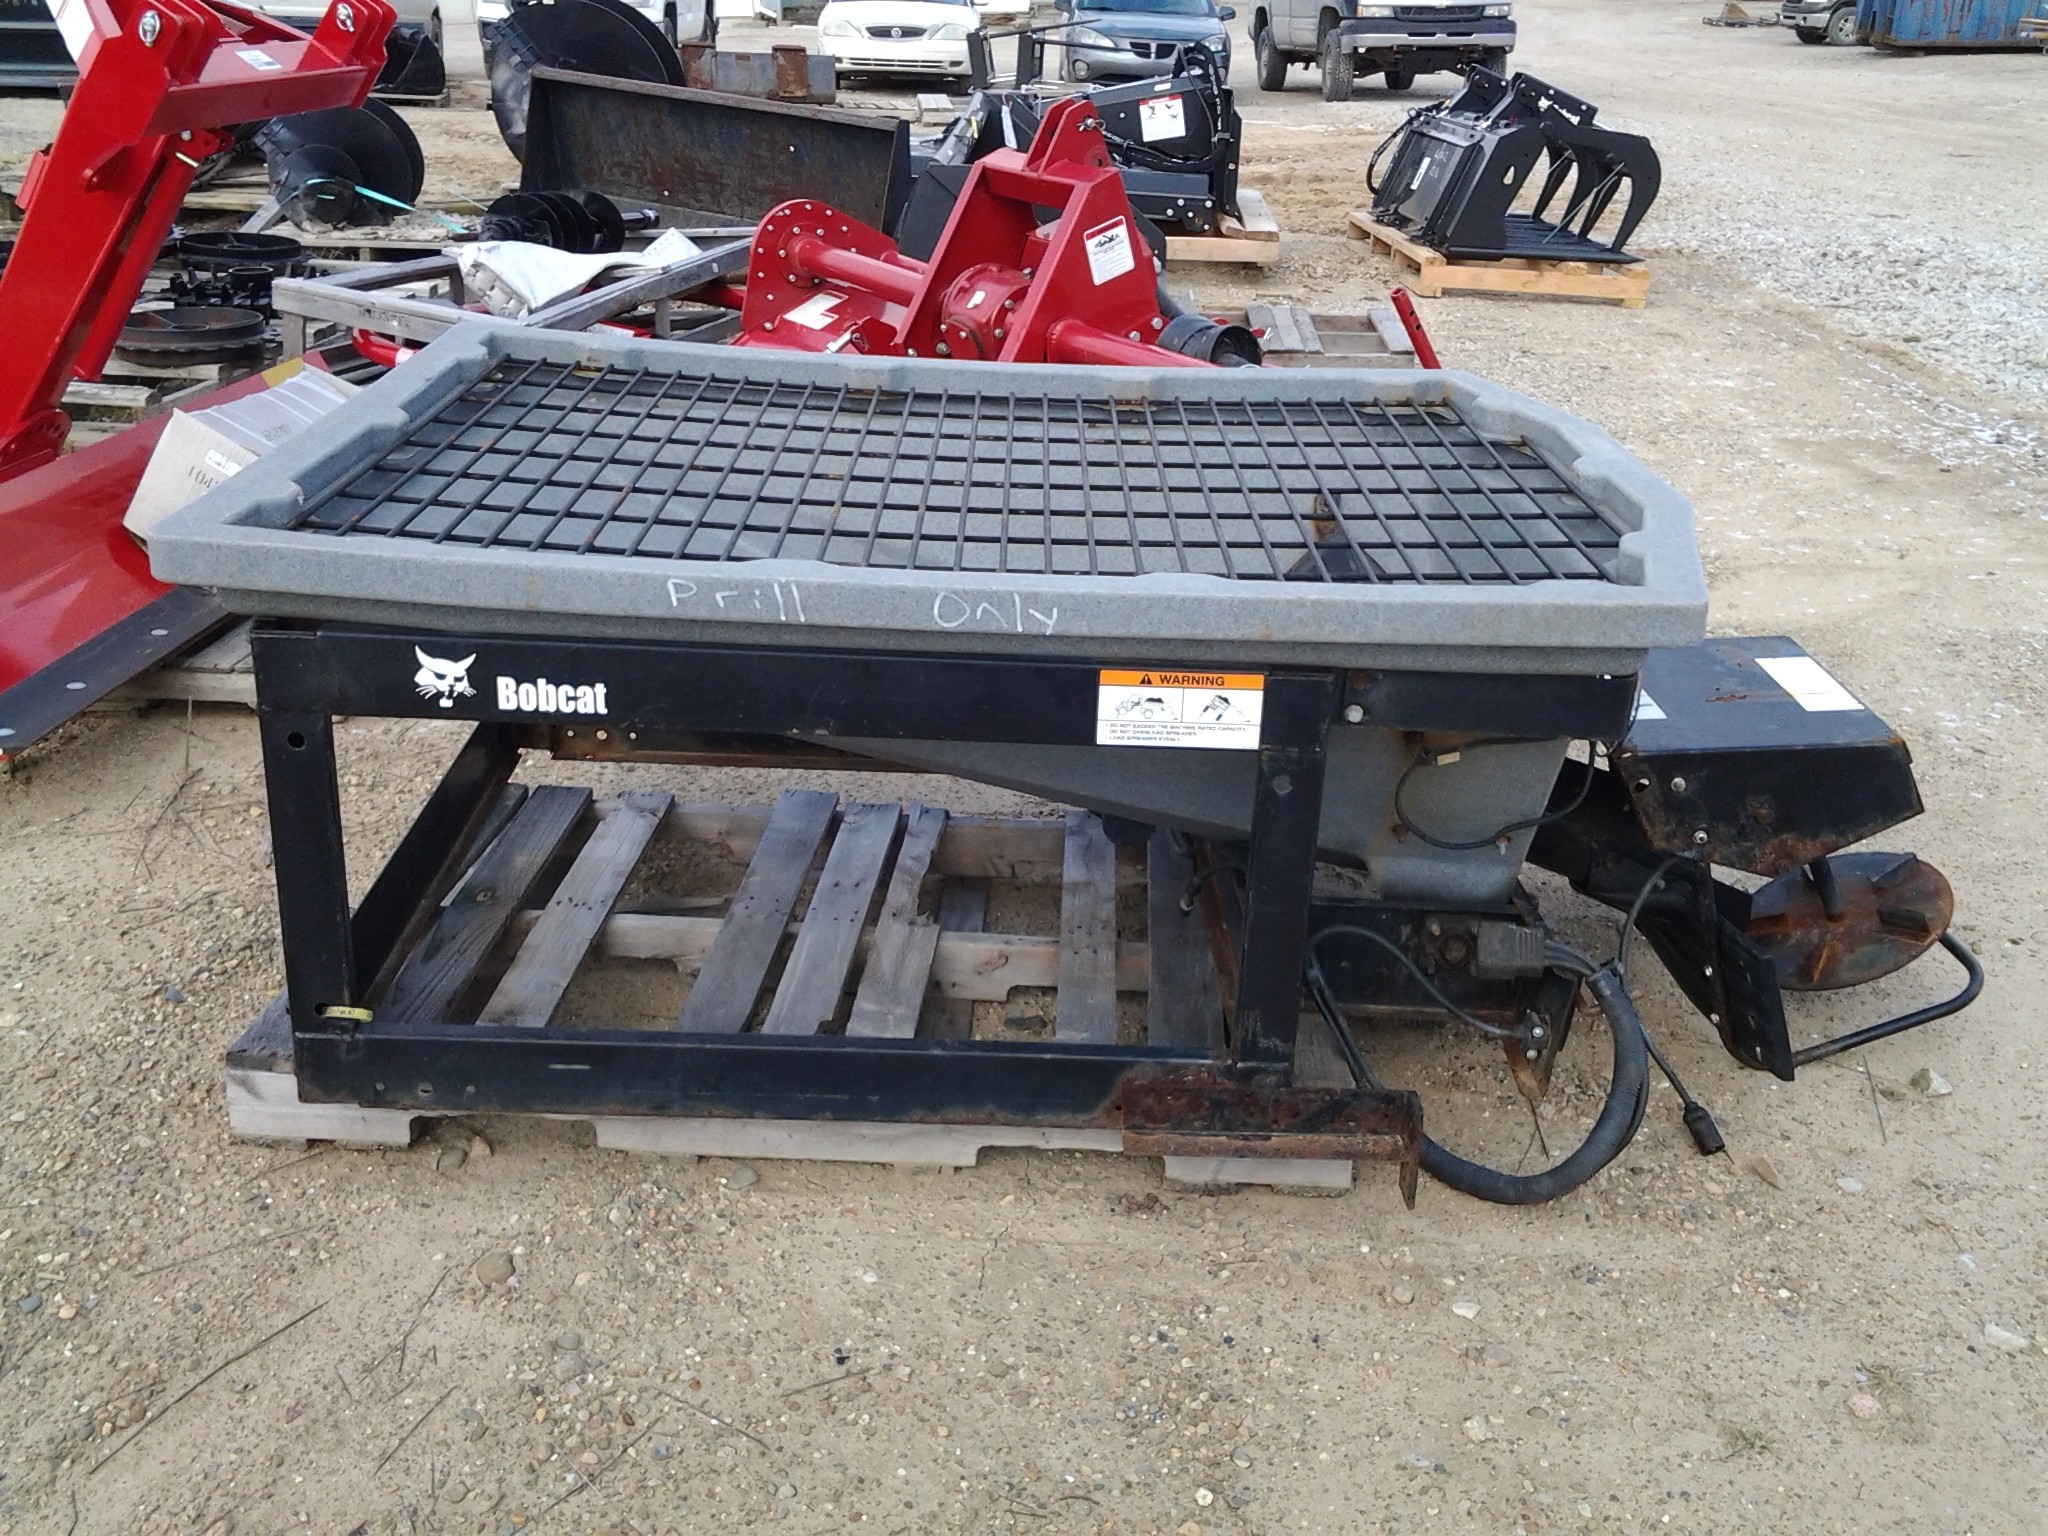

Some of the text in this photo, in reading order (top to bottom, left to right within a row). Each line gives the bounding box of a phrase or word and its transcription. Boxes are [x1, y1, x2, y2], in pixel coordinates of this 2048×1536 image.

[667, 578, 1059, 636] Prill Only
[495, 675, 609, 715] Bobcat
[1159, 674, 1225, 687] WARNING
